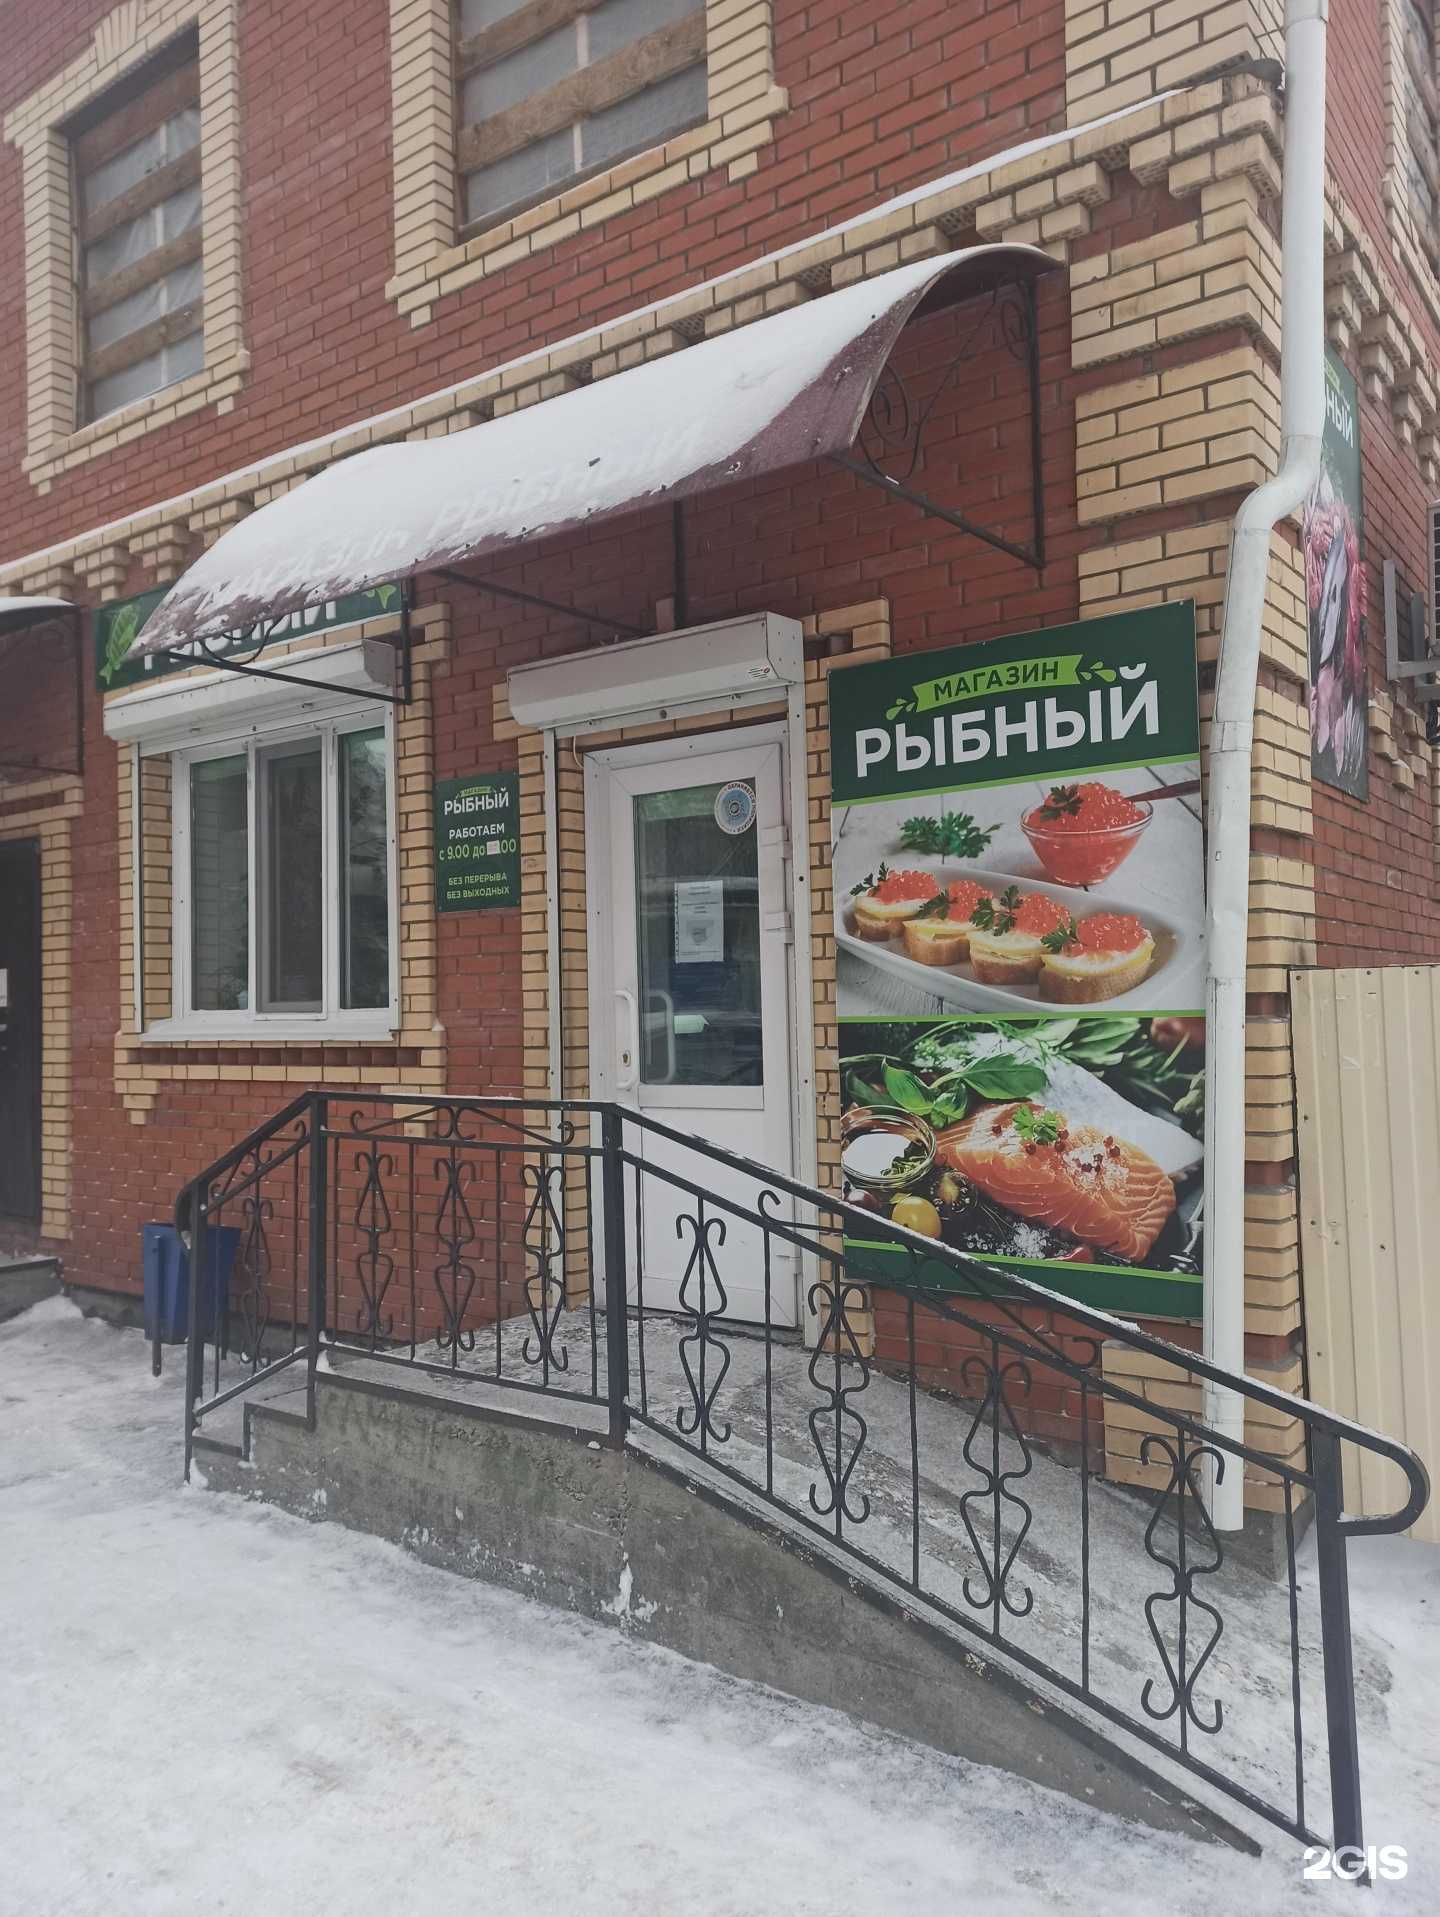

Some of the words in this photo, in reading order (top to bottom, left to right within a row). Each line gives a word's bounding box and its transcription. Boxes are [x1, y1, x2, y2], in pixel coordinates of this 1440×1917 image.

[1326, 384, 1353, 449] НЫЙ
[933, 660, 1059, 702] МАГАЗИН
[855, 662, 1160, 778] РЫБНЫЙ
[444, 787, 509, 815] РЫБНЫЙ
[449, 823, 505, 839] РАБОТАЕМ
[447, 844, 470, 860] 9.00
[472, 845, 486, 860] до
[448, 876, 463, 886] БЕЗ
[464, 872, 507, 885] ПЕРЕРЫВА
[446, 890, 461, 899] БЕЗ
[463, 886, 510, 898] ВЫХОДНЫХ
